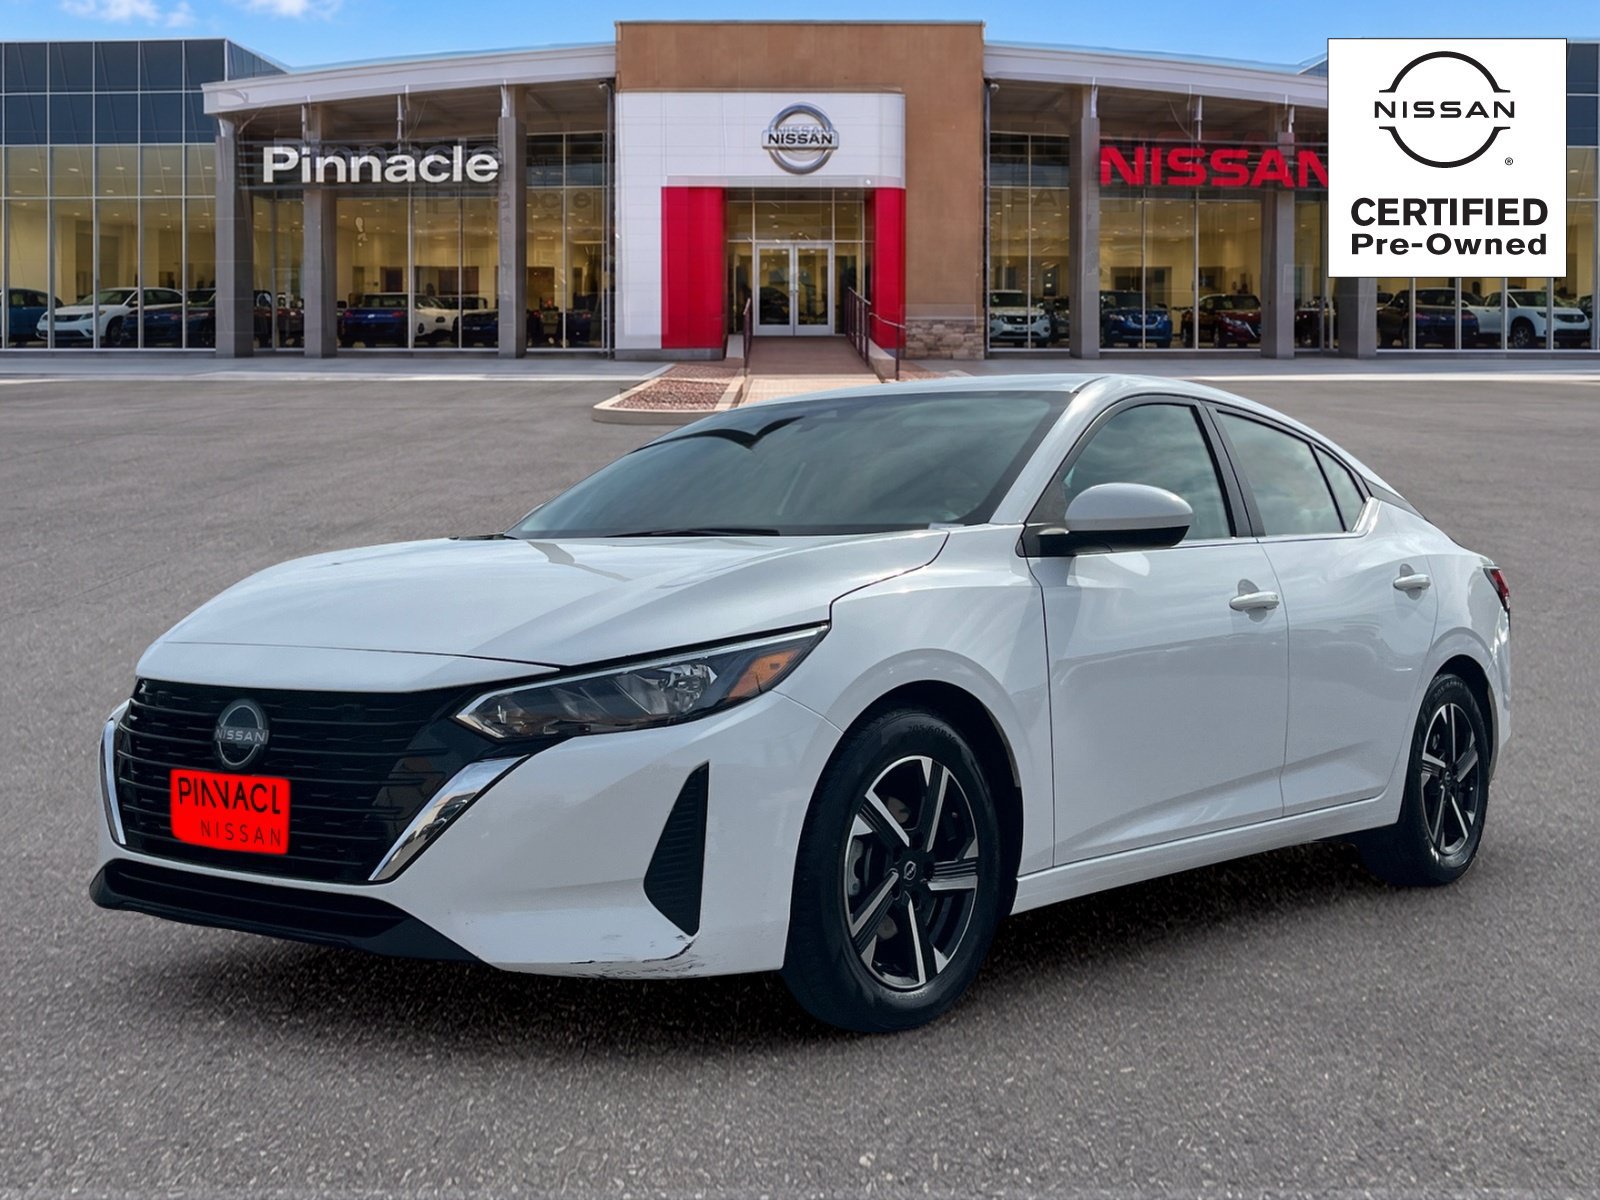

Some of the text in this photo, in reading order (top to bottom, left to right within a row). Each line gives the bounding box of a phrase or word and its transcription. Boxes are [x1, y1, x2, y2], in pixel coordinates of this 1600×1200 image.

[768, 133, 832, 144] NISSAN
[263, 146, 499, 184] Pinnacle
[215, 729, 266, 742] NISSAN
[201, 820, 281, 846] NISSAN
